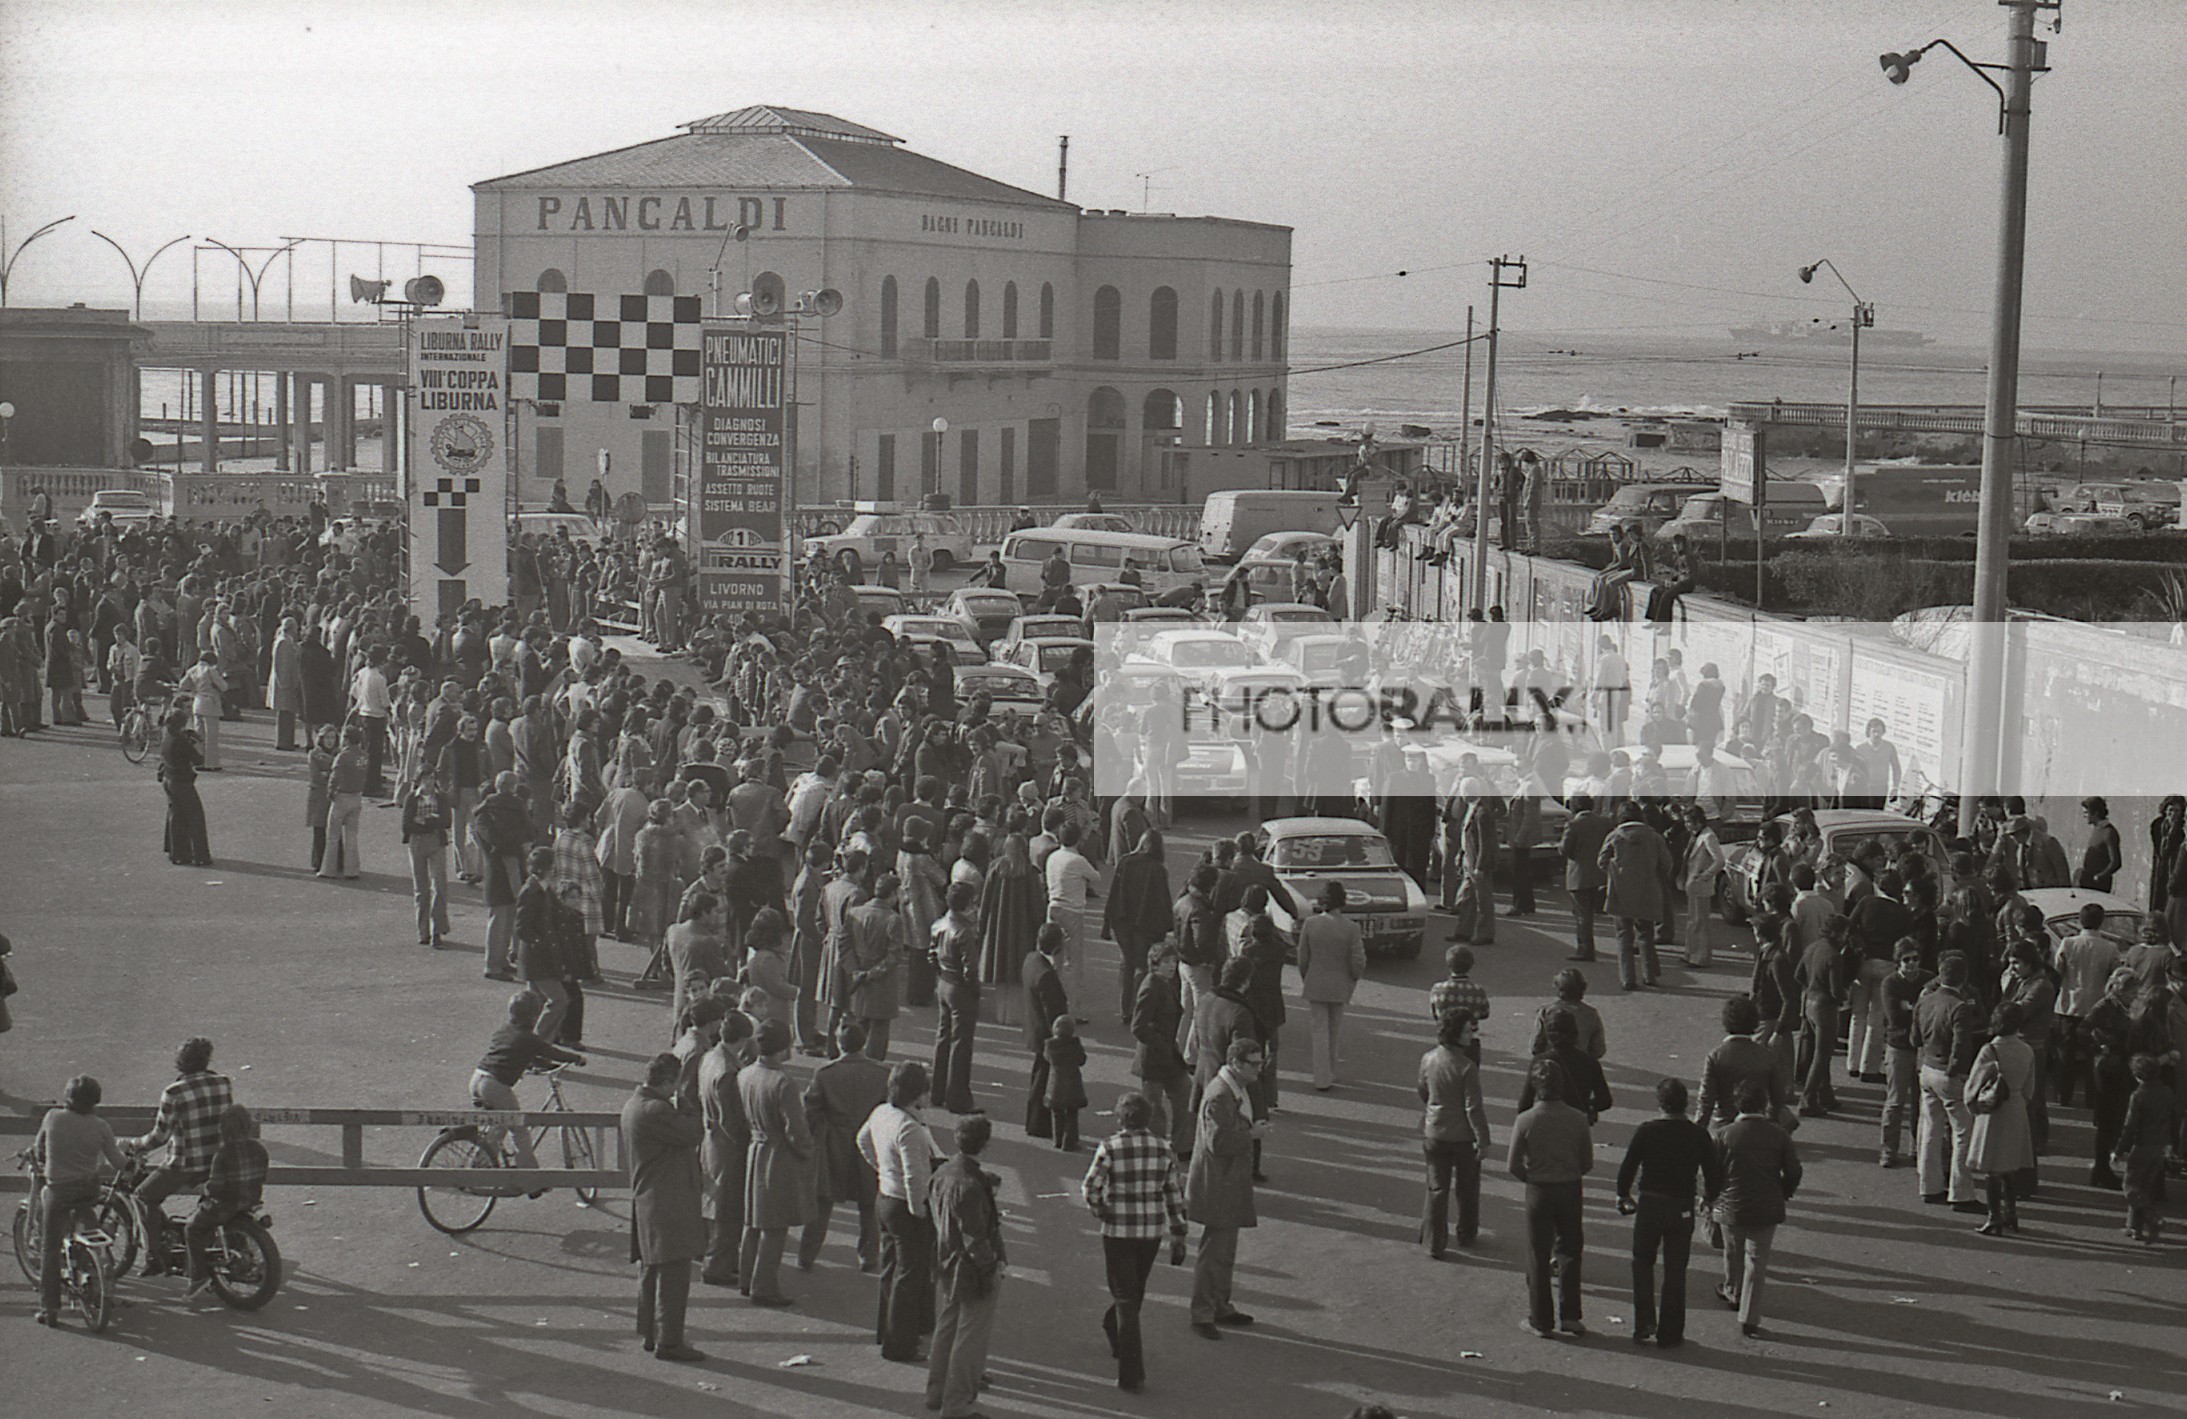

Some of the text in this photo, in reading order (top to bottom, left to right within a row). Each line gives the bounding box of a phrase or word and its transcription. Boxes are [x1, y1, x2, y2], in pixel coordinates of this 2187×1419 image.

[537, 196, 787, 231] PANCALDI
[967, 218, 1023, 239] PANCALDI
[420, 332, 503, 351] LIBURNA RALLY
[420, 352, 486, 362] INTERNAZIONALE
[705, 336, 782, 365] PNEUMATICI
[447, 370, 499, 389] COPPA
[705, 367, 782, 408] CAMMILLI
[420, 391, 498, 410] LIBURNA
[714, 417, 766, 432] DIAGNOSI
[707, 432, 780, 447] CONVERGENZA
[705, 452, 770, 465] BILANCIATURA
[717, 464, 780, 478] TRASMISSIONI
[704, 483, 775, 496] ASSETTO RUOTE
[704, 499, 777, 513] SISTEMA BEAR
[737, 530, 744, 546] 1
[719, 555, 782, 569] RALLY
[710, 582, 764, 596] LIVORNO
[703, 600, 778, 611] VIA PIAN DI ROTA
